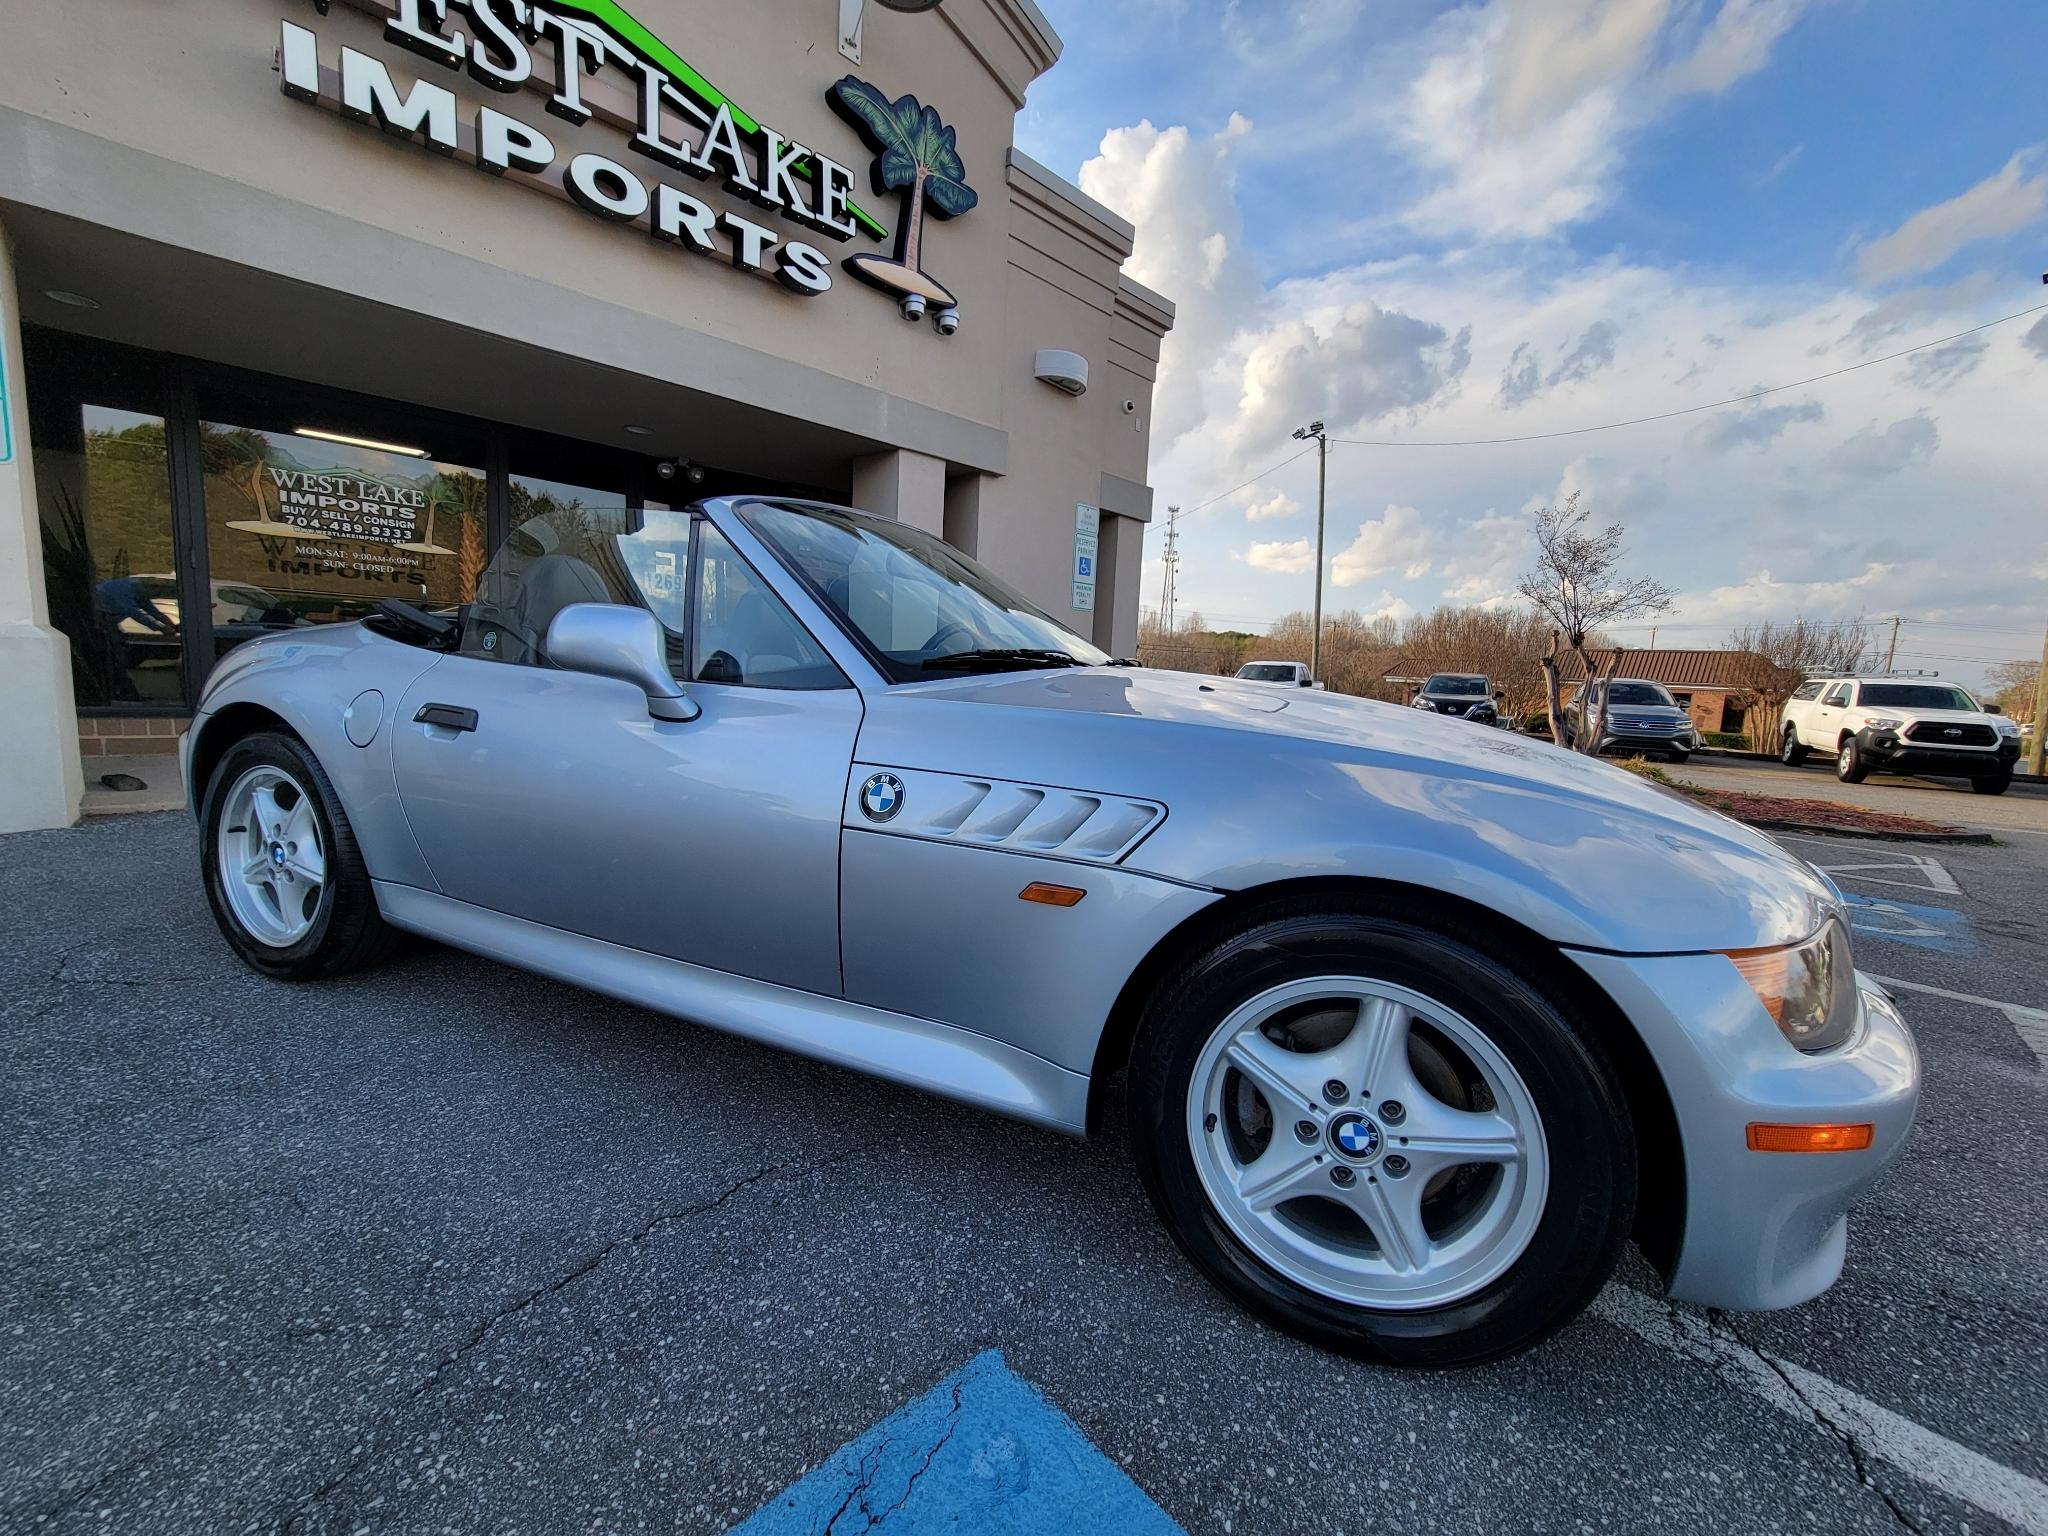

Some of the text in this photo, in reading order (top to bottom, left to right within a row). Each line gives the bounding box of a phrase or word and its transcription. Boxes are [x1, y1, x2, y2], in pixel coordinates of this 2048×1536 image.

[387, 0, 857, 238] EST LAKE
[280, 19, 833, 292] IMPORTS
[267, 467, 425, 508] WEST LAKE
[279, 489, 417, 519] IMPORTS
[281, 504, 308, 516] BUY
[321, 510, 350, 521] SELL
[363, 515, 416, 530] CONSIGN
[285, 515, 412, 540] 704.489.9333
[295, 545, 420, 567] MON-SAT: 9:00AM-6:00PM
[323, 559, 394, 573] SUN: CLOSED
[867, 775, 902, 792] BMW
[1360, 1118, 1379, 1156] BMW
